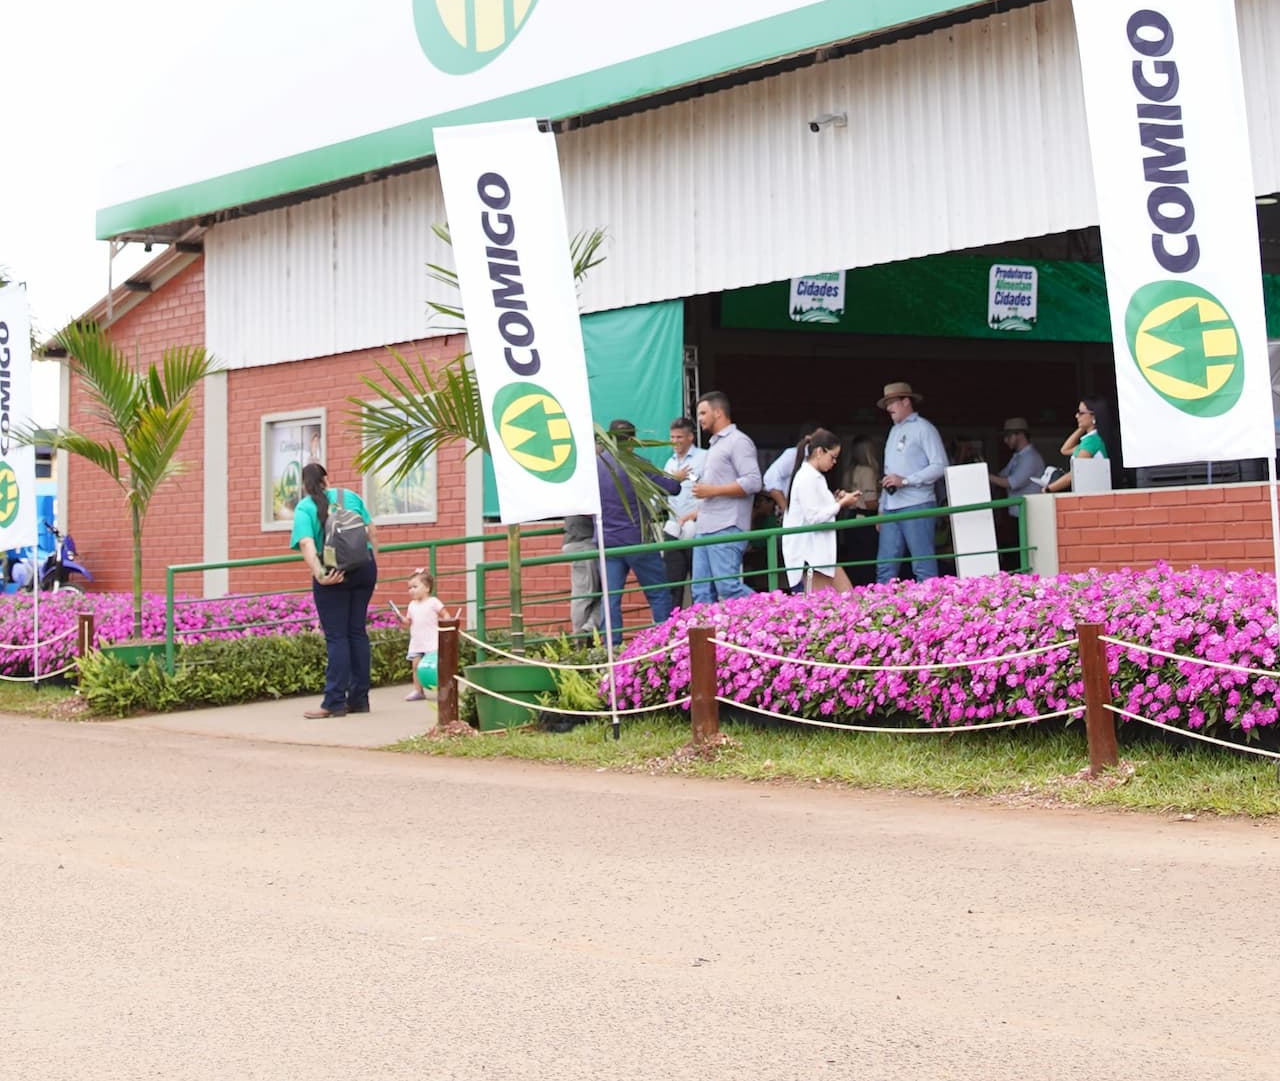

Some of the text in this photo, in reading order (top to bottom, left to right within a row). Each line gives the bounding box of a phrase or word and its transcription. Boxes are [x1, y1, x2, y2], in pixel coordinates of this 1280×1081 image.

[1126, 9, 1201, 274] COMIGO
[476, 171, 541, 377] COMIGO
[995, 267, 1033, 280] Produtores
[797, 281, 839, 297] Cidades
[994, 291, 1031, 306] Cidades
